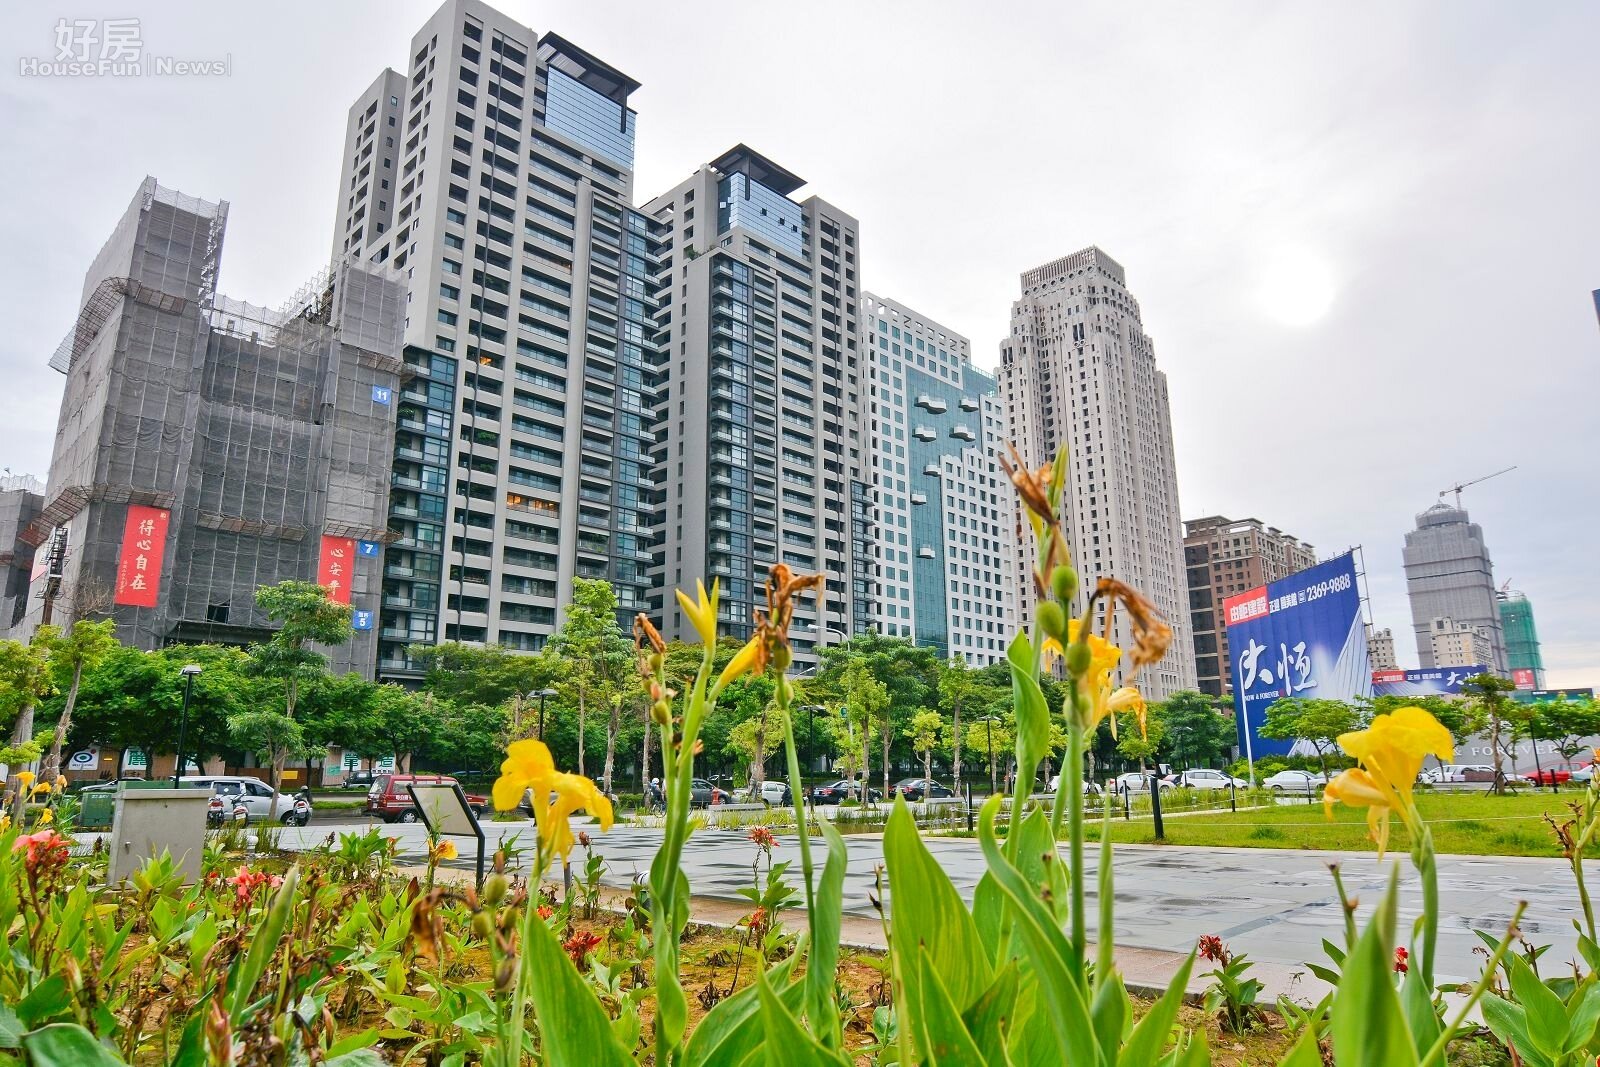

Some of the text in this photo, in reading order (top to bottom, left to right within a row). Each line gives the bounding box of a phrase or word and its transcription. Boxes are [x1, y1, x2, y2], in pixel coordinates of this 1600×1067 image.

[376, 390, 388, 401] 11
[129, 519, 155, 590] 得心自在
[365, 544, 374, 554] 7
[1306, 573, 1351, 601] 2369-9888
[359, 618, 366, 627] 5
